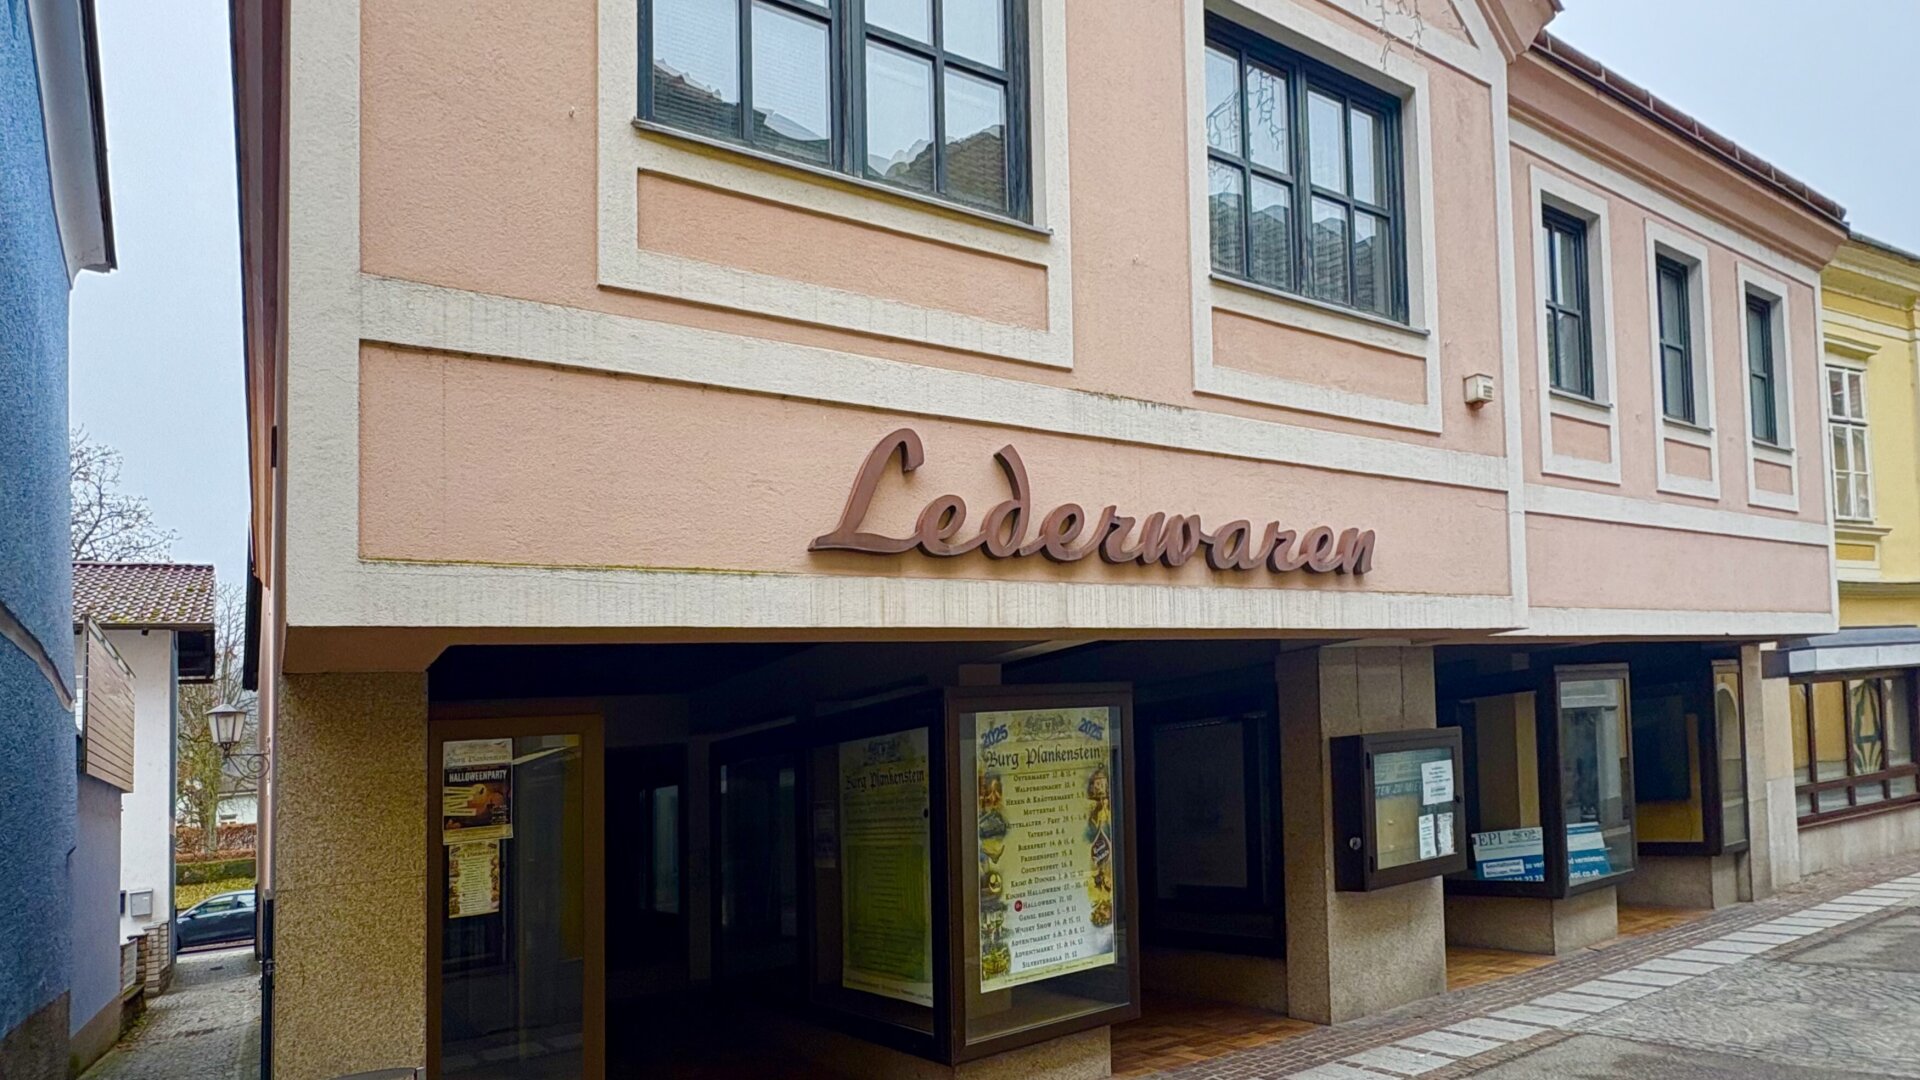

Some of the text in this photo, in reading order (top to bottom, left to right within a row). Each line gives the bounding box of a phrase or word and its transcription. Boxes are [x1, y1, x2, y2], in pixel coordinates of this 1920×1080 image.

[807, 427, 1375, 575] Lederwaren
[981, 724, 1009, 748] 2025
[1078, 717, 1105, 741] 2025
[985, 743, 1101, 770] Burg Plankenstein
[448, 769, 508, 783] HALLOWEENPARTY
[1477, 832, 1504, 847] EPI
